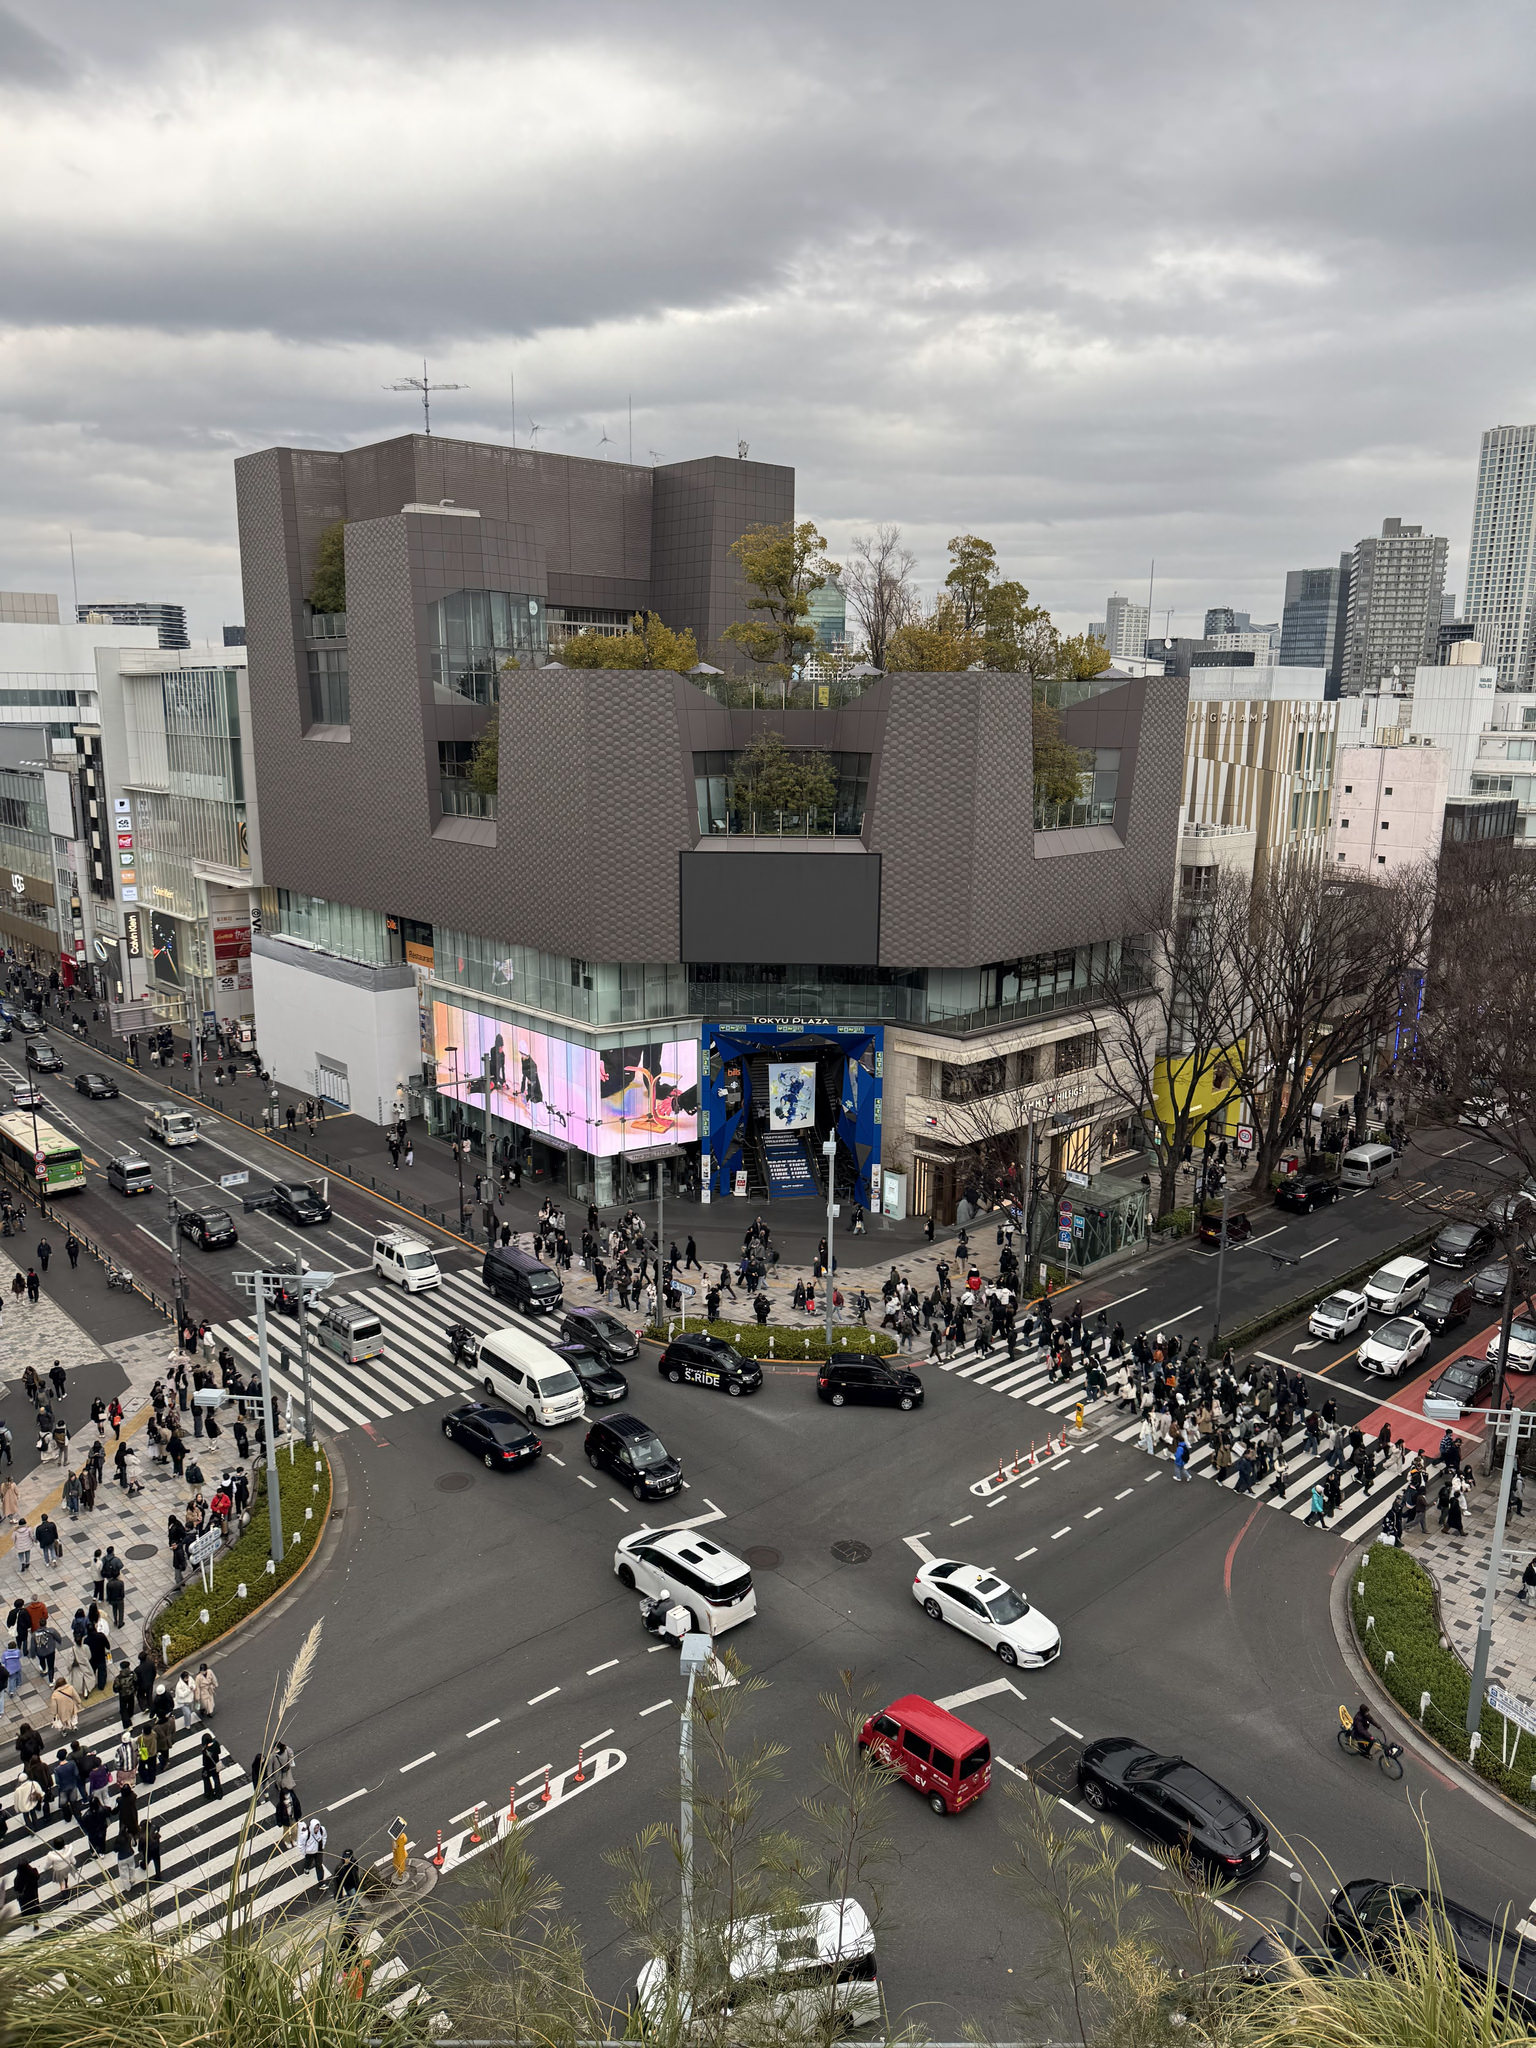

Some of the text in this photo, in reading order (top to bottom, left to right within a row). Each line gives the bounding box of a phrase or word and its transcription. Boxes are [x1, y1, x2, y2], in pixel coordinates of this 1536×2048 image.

[1186, 712, 1269, 724] ONGCHAMP
[11, 873, 25, 893] UGG
[128, 915, 139, 954] Calvin Klein
[408, 950, 433, 963] Restaurant
[752, 1016, 829, 1025] TOKYU PLAZA
[1016, 1085, 1087, 1112] TOMMY HILFIGER
[1241, 1132, 1250, 1140] 50
[684, 1370, 720, 1387] S.RIDE
[914, 1774, 927, 1787] EV
